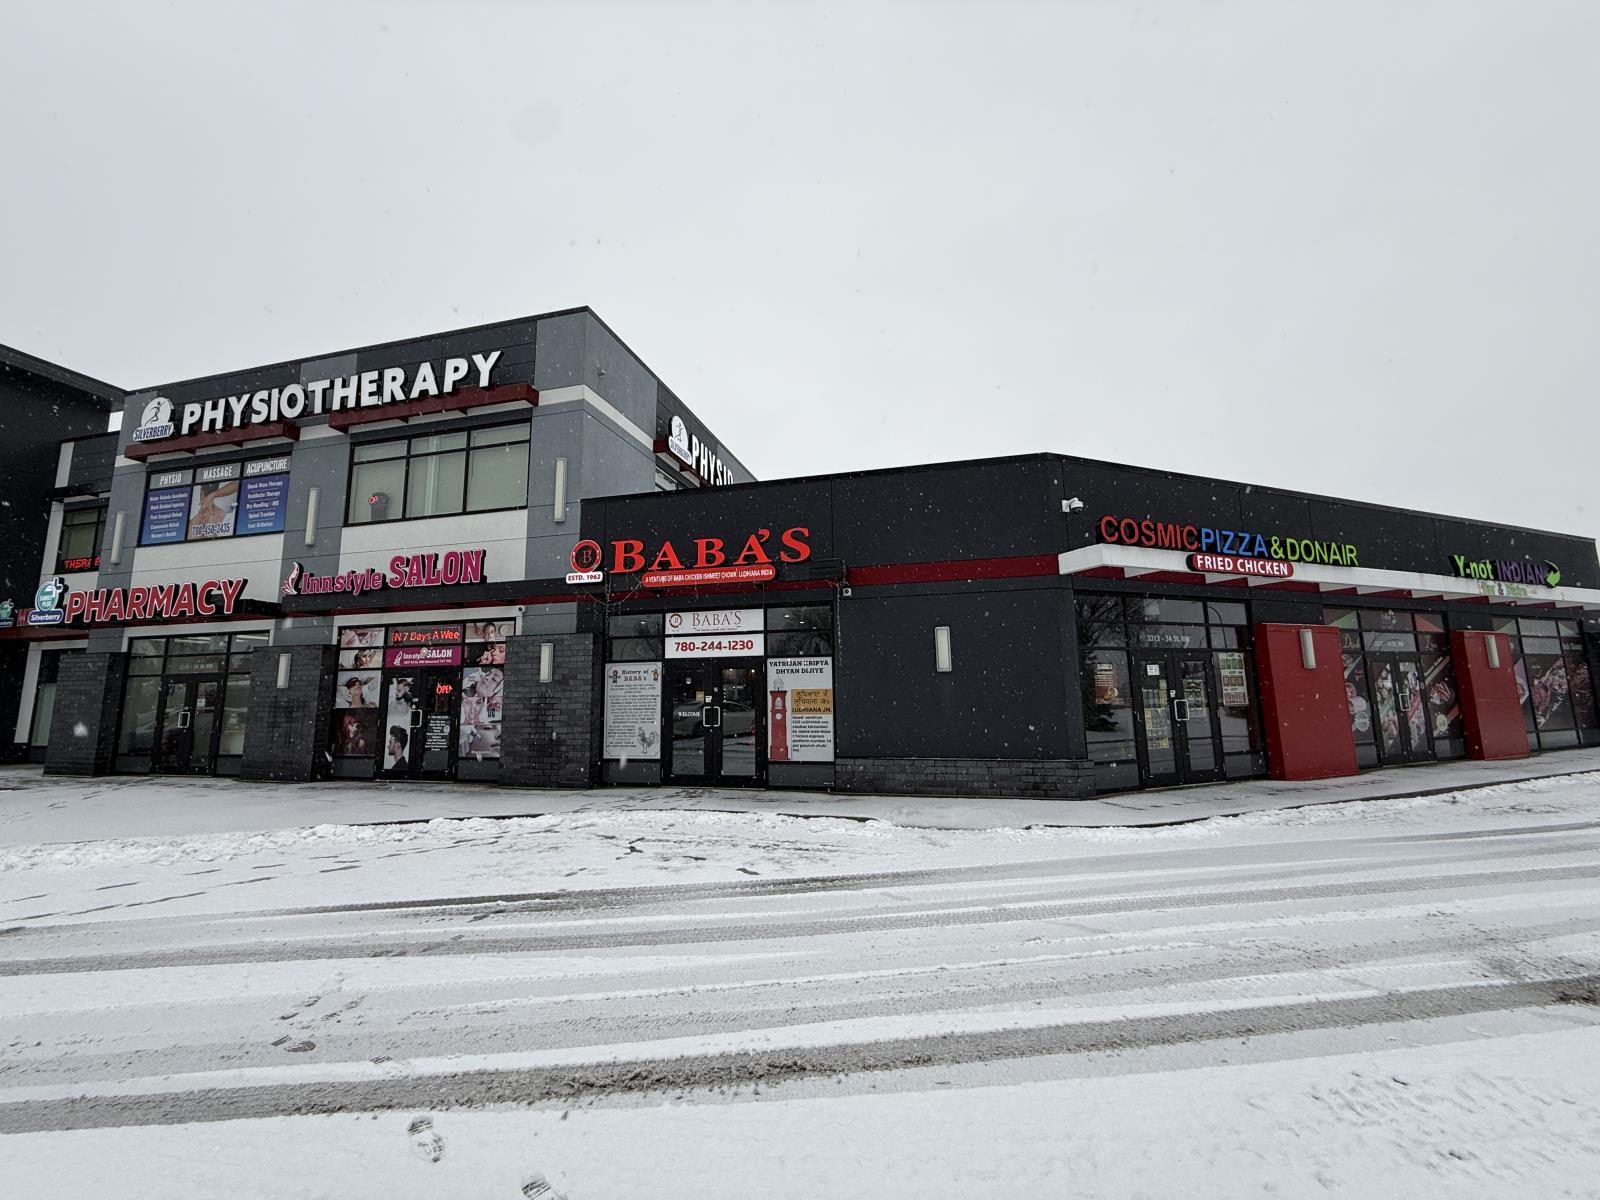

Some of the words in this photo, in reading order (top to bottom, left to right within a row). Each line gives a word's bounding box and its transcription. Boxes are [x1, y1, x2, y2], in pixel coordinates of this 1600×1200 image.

[181, 350, 502, 435] PHYSIOTHERAPY
[134, 424, 172, 440] SILVERBERRY
[203, 466, 233, 480] MASSAGE
[246, 458, 288, 474] ACUPUNCTURE
[160, 473, 182, 486] PHYSIO
[1100, 515, 1199, 551] COSMIC
[1200, 527, 1269, 557] PIZZA
[1270, 536, 1286, 559] &
[1286, 538, 1360, 567] DONAIR
[610, 527, 811, 574] BABA'S
[300, 568, 383, 595] Innstyle
[388, 550, 483, 588] SALON
[1196, 555, 1233, 571] FRIED
[1237, 557, 1289, 576] CHICKEN
[1454, 554, 1494, 580] Y-not
[1495, 559, 1545, 585] INDIAN
[685, 573, 702, 581] CHICKEN
[738, 570, 760, 578] LUDHIANA
[64, 578, 244, 623] PHARMACY
[692, 611, 742, 626] BABA'S
[402, 632, 408, 642] 7
[410, 631, 431, 642] Days
[432, 631, 439, 640] A
[426, 649, 453, 658] SALON
[674, 640, 754, 652] 780-244-1230
